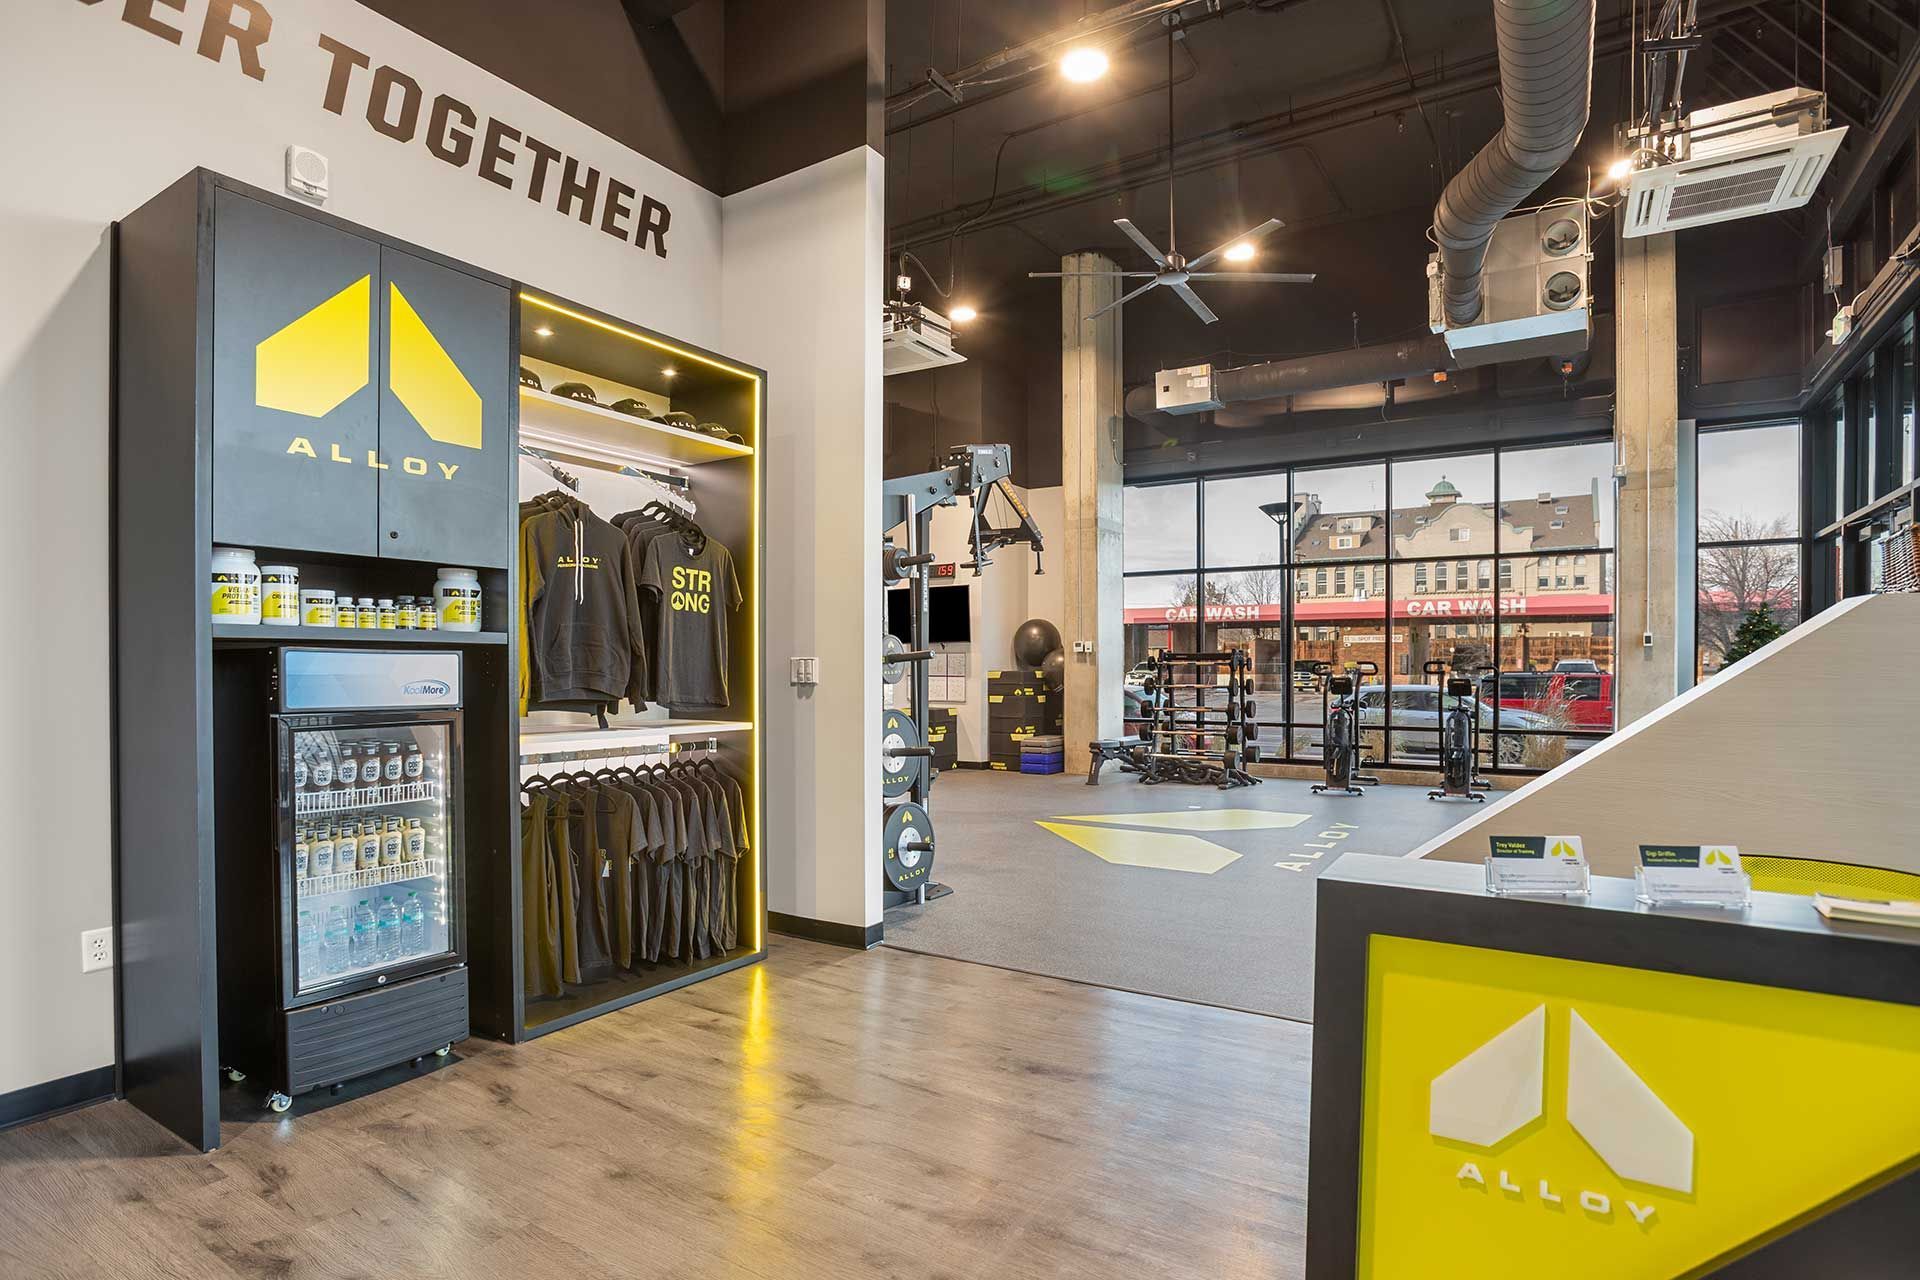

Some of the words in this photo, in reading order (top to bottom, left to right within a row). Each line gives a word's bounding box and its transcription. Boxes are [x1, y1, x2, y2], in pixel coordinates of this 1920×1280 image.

[77, 0, 273, 82] ER
[318, 33, 672, 260] TOGETHER
[286, 437, 460, 480] ALLOY
[557, 556, 599, 564] ALOY
[671, 566, 712, 593] STR
[671, 591, 710, 614] ONG
[1205, 606, 1260, 620] WASH
[1406, 600, 1452, 616] CAR
[1458, 598, 1527, 615] WASH
[403, 685, 444, 695] KoolMore
[1273, 822, 1360, 872] ALLOY
[899, 867, 926, 882] ALLOY
[1456, 1162, 1656, 1223] ALLOY
